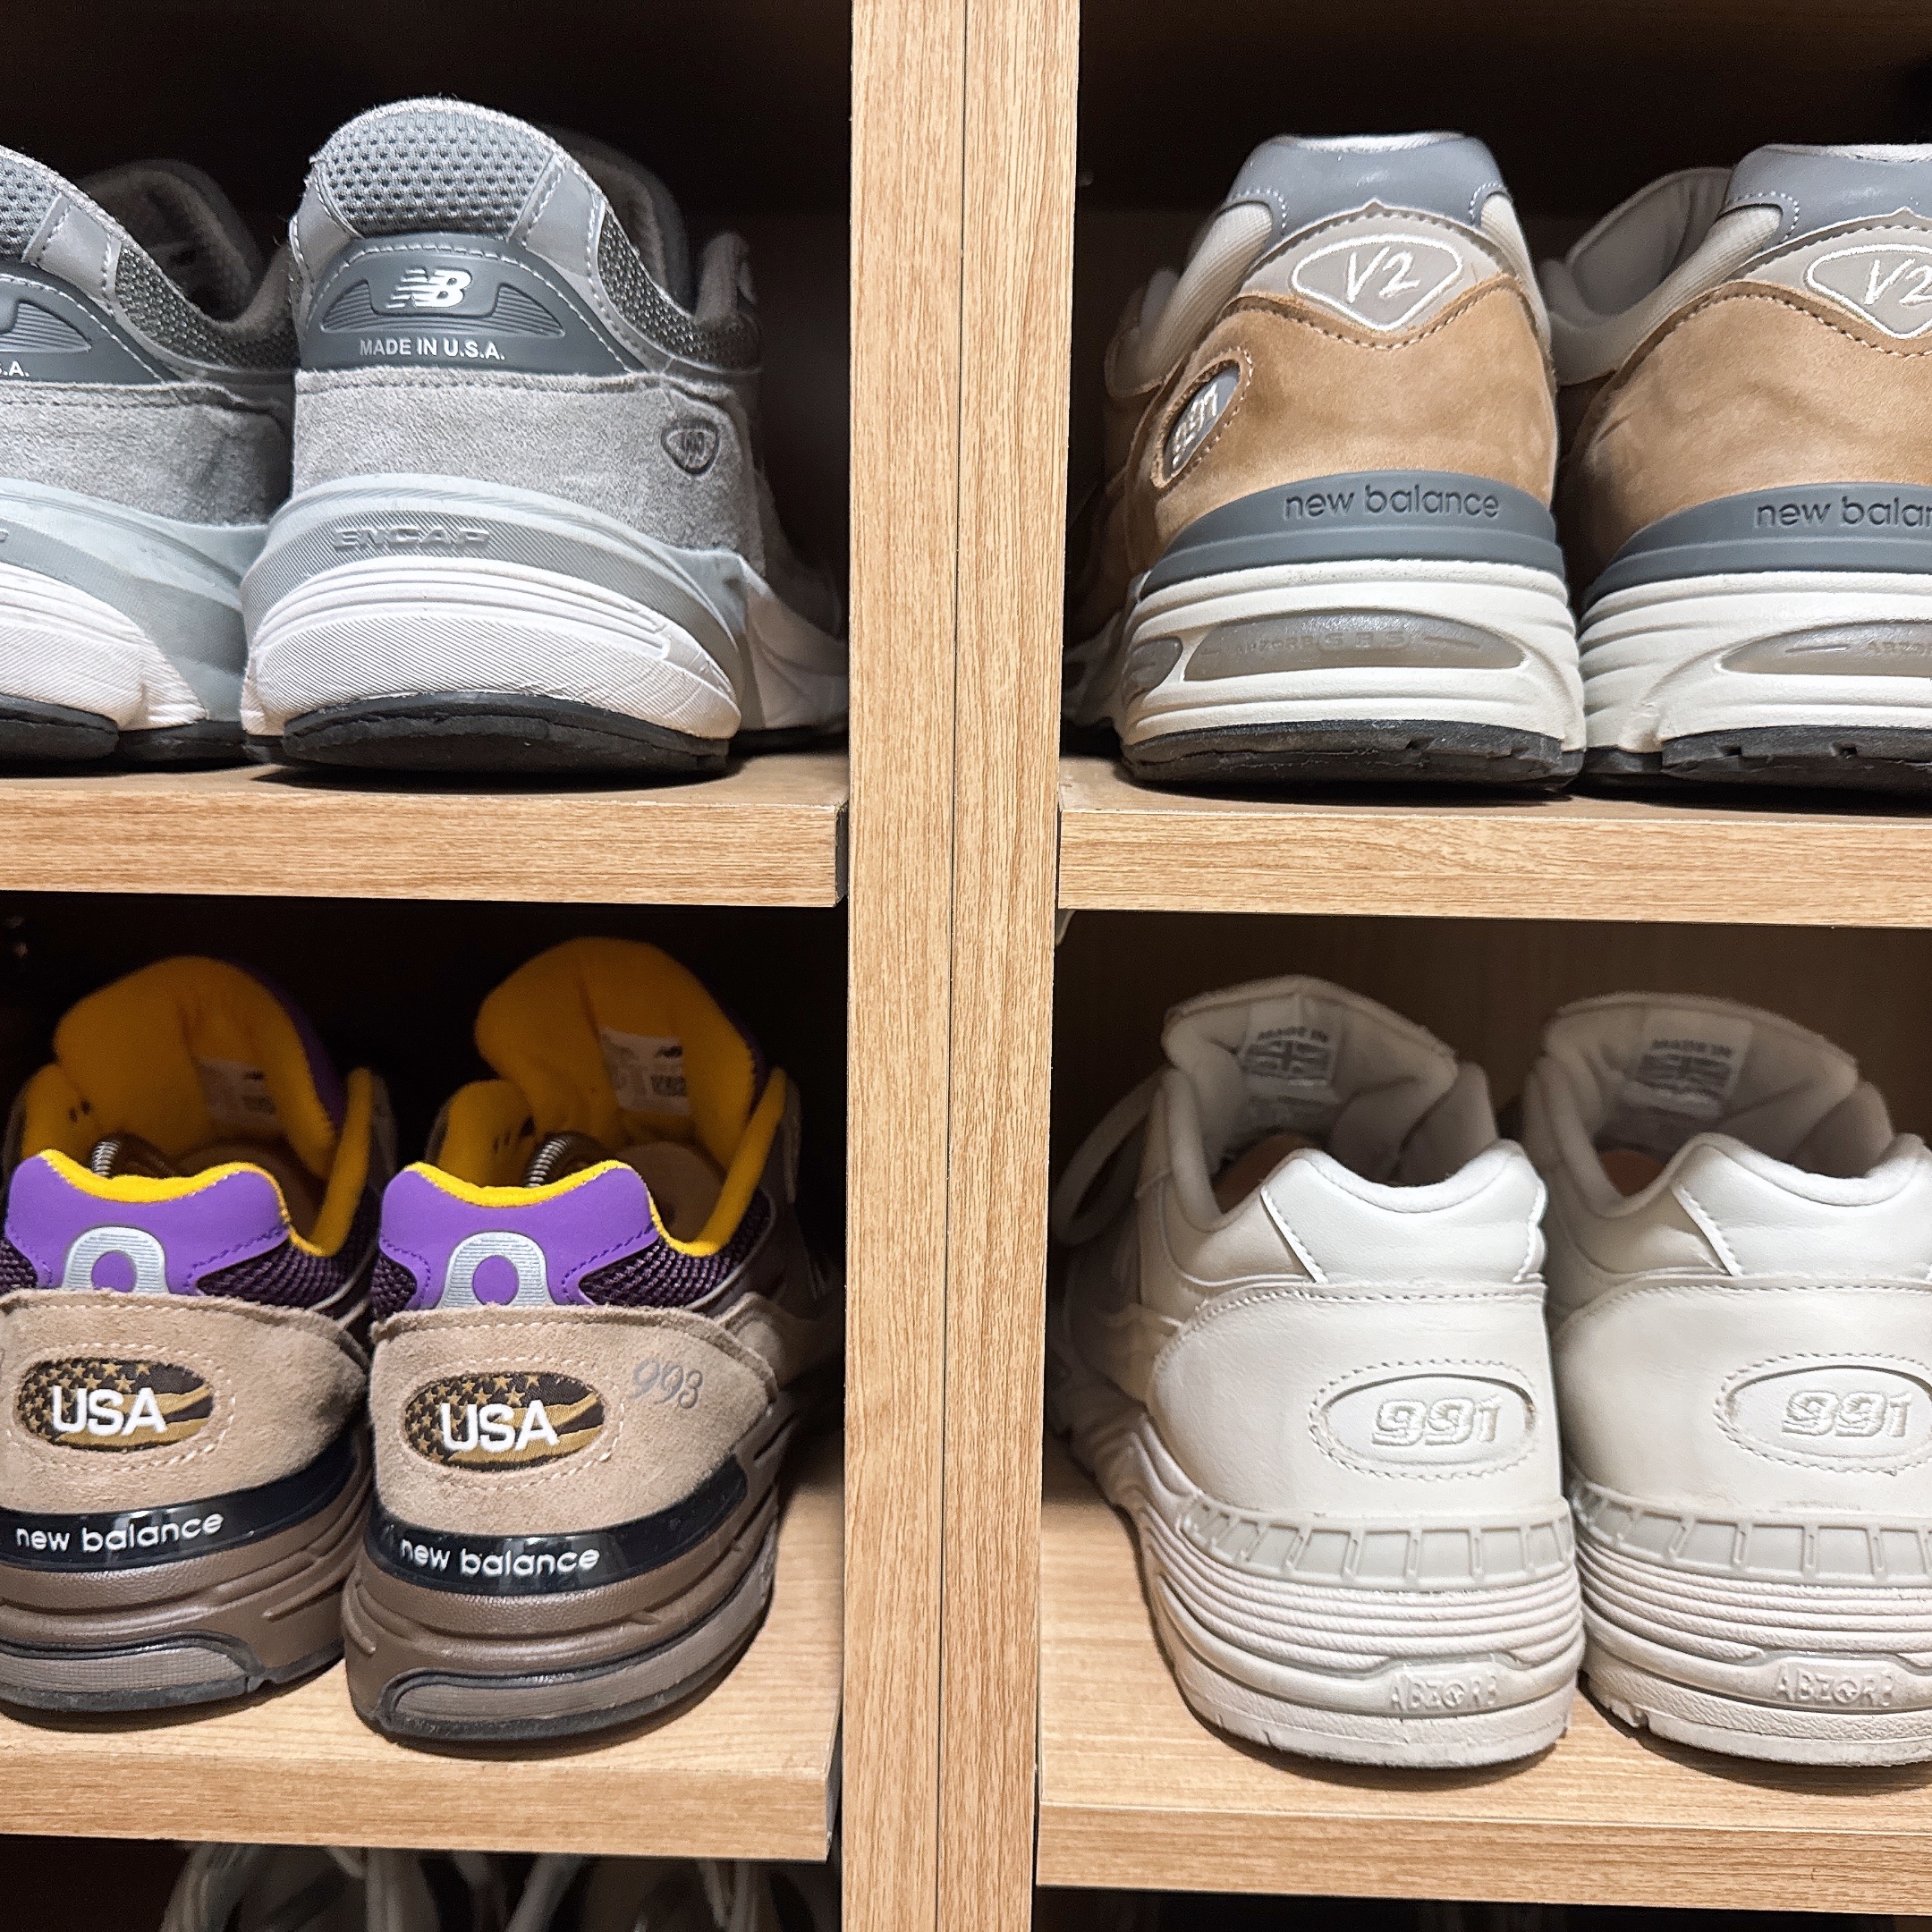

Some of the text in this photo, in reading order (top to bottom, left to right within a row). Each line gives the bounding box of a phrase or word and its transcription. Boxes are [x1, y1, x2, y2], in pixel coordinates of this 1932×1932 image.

[1347, 246, 1420, 303] V2
[1864, 258, 1932, 304] V2
[360, 337, 505, 360] MADE IN U.S.A.
[1284, 484, 1500, 521] new balance
[1756, 502, 1832, 527] new
[333, 526, 489, 547] ENCAP
[630, 1357, 703, 1410] 993
[52, 1385, 167, 1435] USA
[440, 1399, 560, 1453] USA
[1371, 1394, 1503, 1446] 991
[1782, 1388, 1912, 1438] 991
[16, 1513, 224, 1553] new balance
[400, 1538, 599, 1576] new balance
